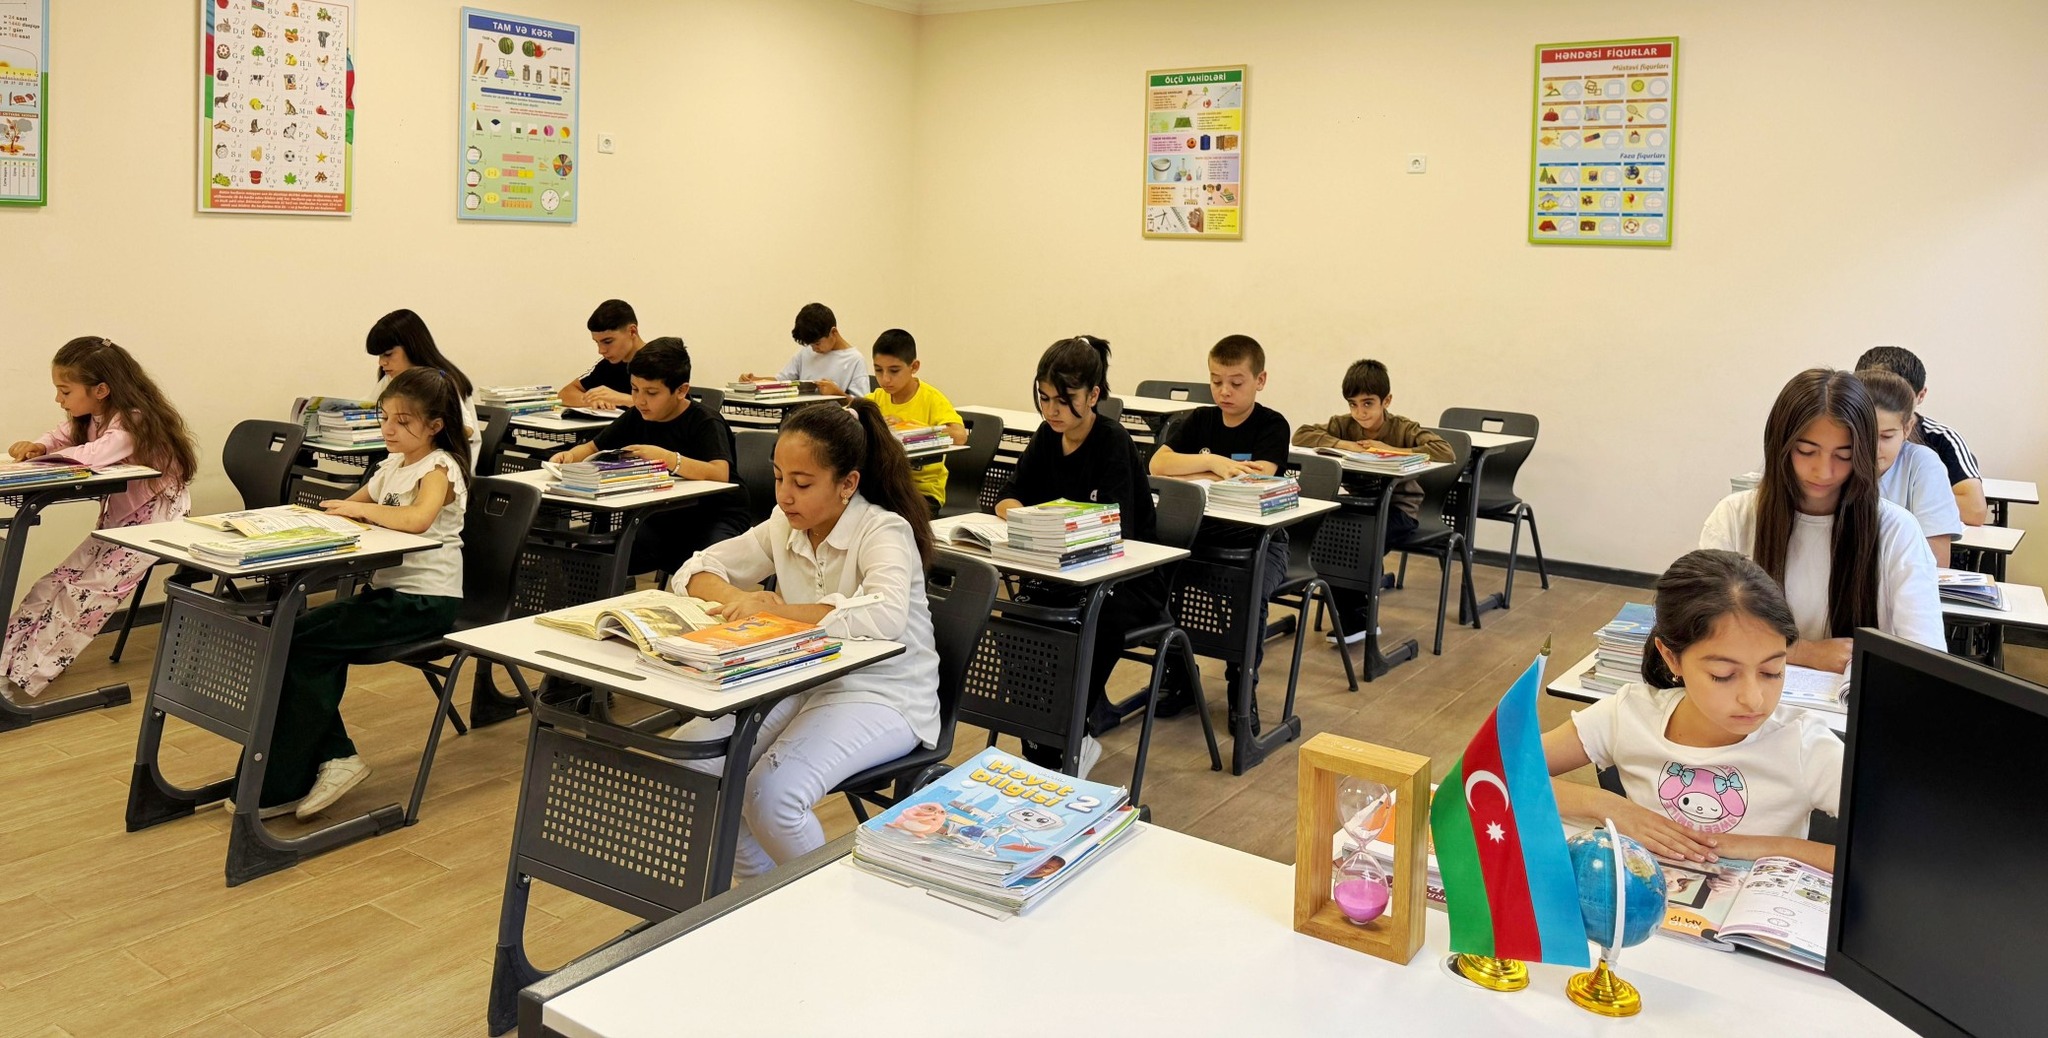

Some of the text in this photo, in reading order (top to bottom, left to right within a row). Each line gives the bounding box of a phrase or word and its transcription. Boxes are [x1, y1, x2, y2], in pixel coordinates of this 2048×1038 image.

[492, 22, 553, 38] TAM VƏ KƏSR
[1555, 48, 1657, 60] HƏNDƏSİ FİQURLAR
[1640, 62, 1668, 71] fiqurları
[1165, 73, 1226, 84] ÖLÇÜ VAHİDLƏRİ
[969, 768, 1063, 807] bilgisi
[1065, 796, 1101, 813] 2
[1698, 815, 1737, 833] SWEET
